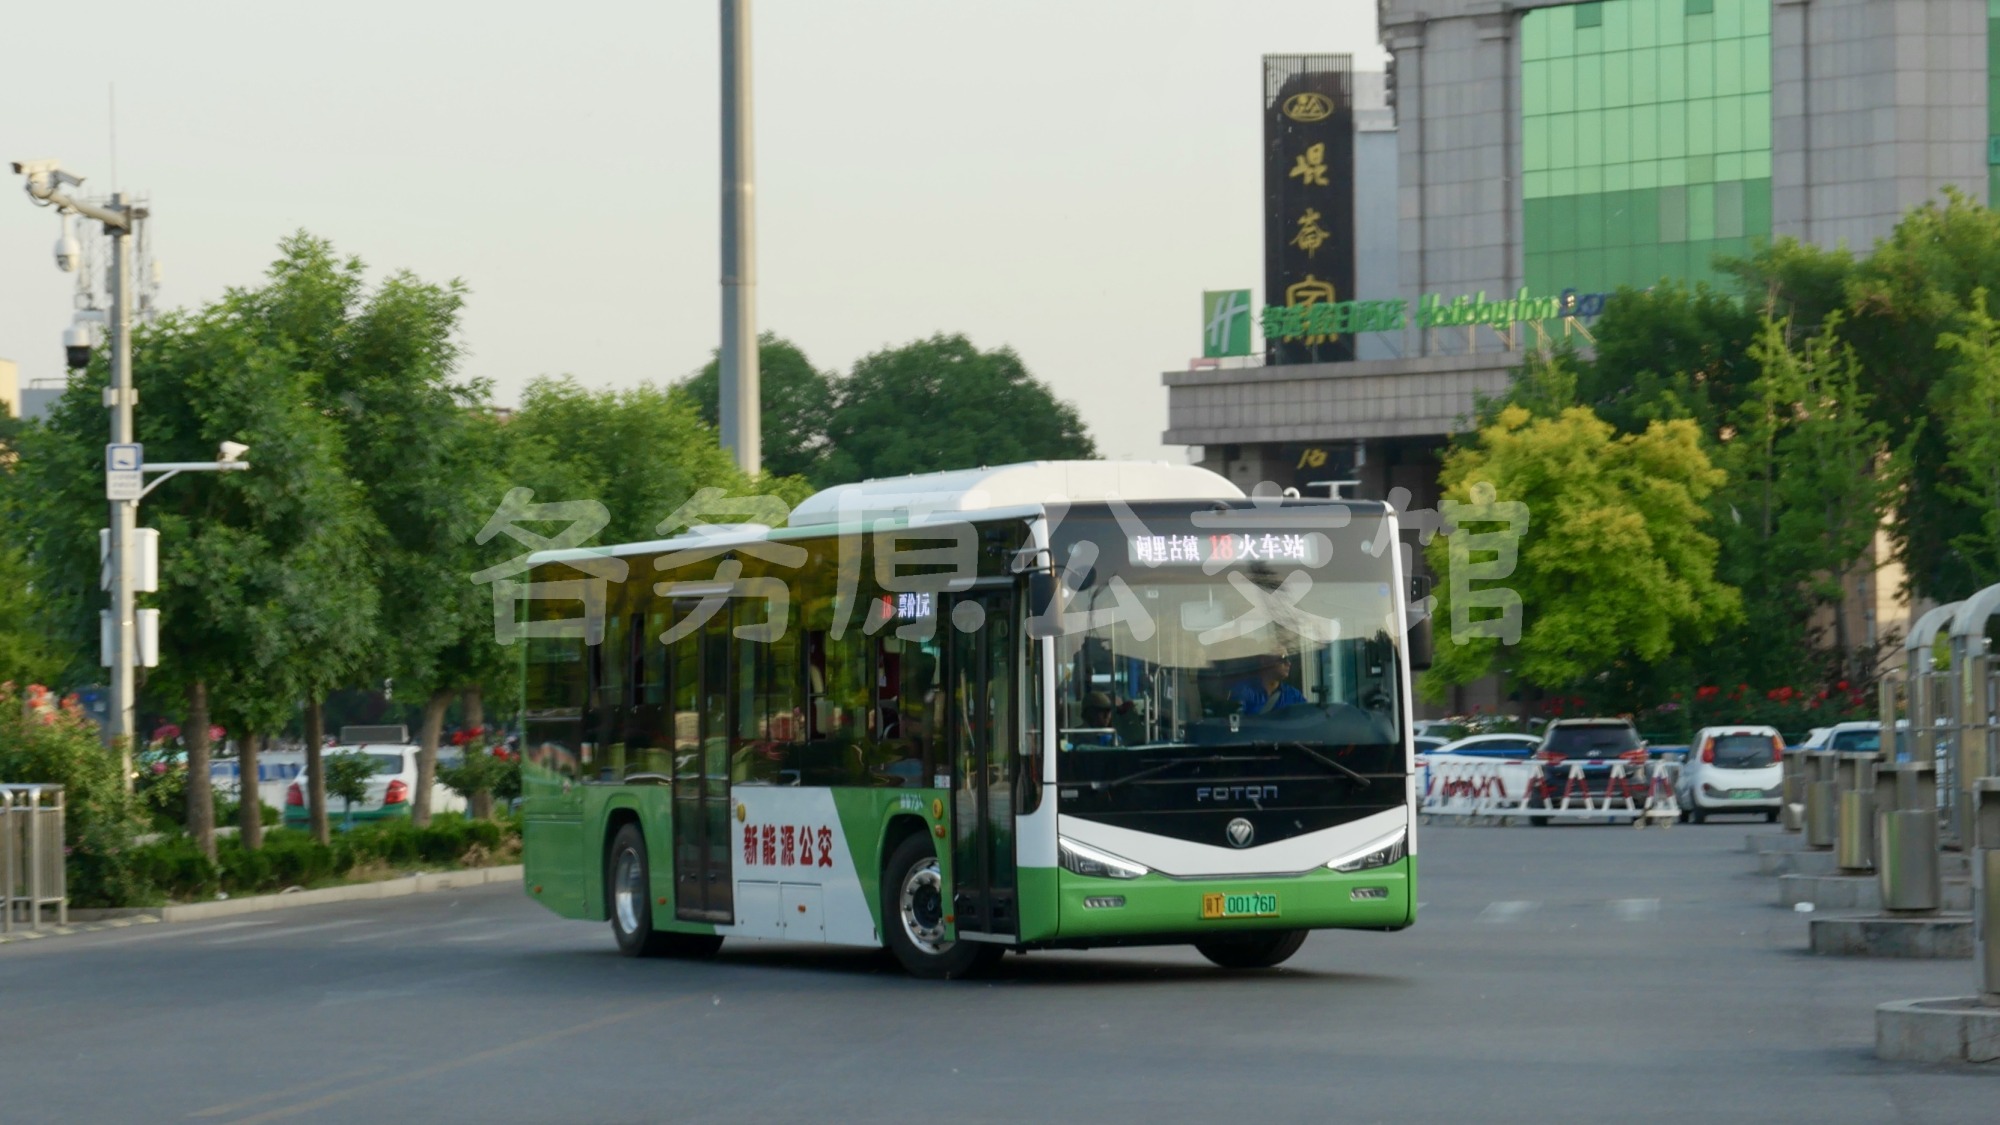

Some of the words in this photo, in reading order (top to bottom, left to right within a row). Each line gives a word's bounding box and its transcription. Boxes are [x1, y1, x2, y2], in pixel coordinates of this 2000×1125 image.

[1209, 534, 1233, 560] 18
[1236, 533, 1305, 560] 火车站
[898, 592, 930, 618] 票价1元
[1196, 785, 1278, 801] FOTON
[744, 824, 833, 867] 新能源公交
